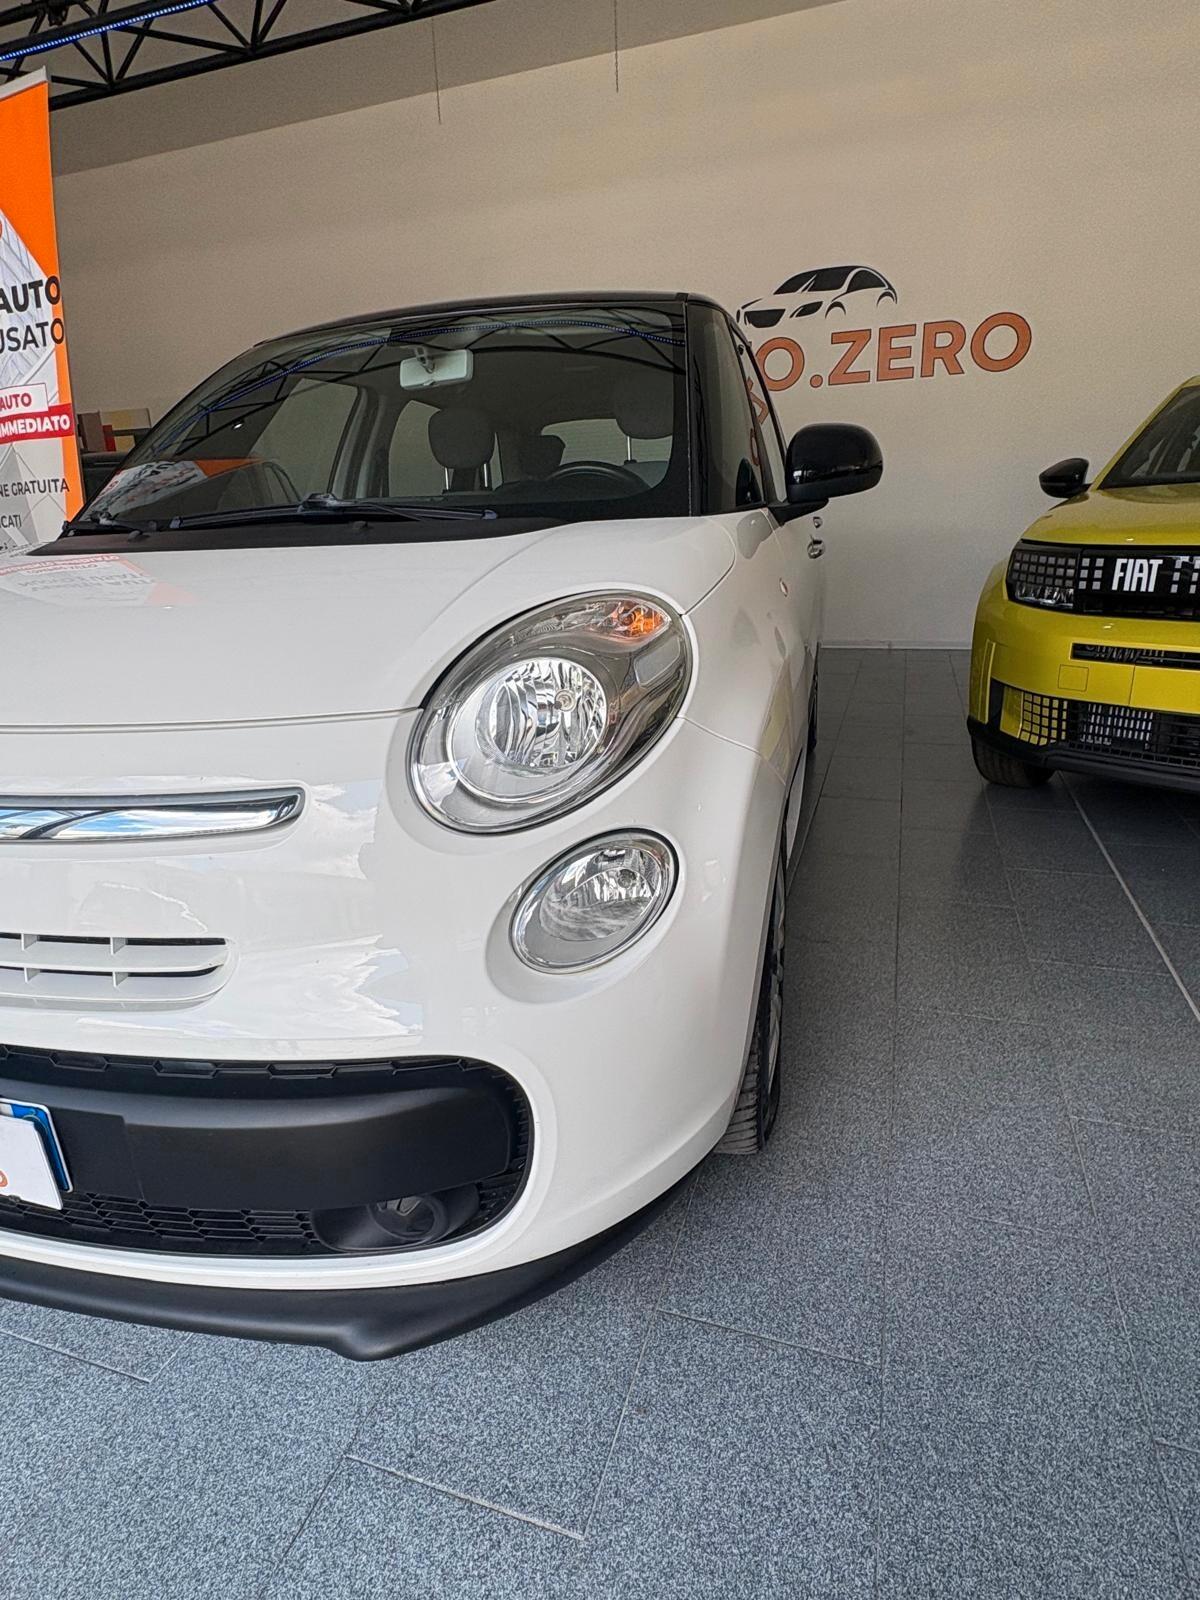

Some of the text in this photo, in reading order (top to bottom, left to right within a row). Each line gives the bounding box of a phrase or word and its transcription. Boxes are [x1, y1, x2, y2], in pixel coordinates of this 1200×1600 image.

[755, 311, 1032, 392] O.ZERO
[0, 392, 33, 411] AUTO
[11, 478, 70, 496] GRATUITA
[0, 514, 22, 528] CATI
[1111, 558, 1164, 592] FIAT
